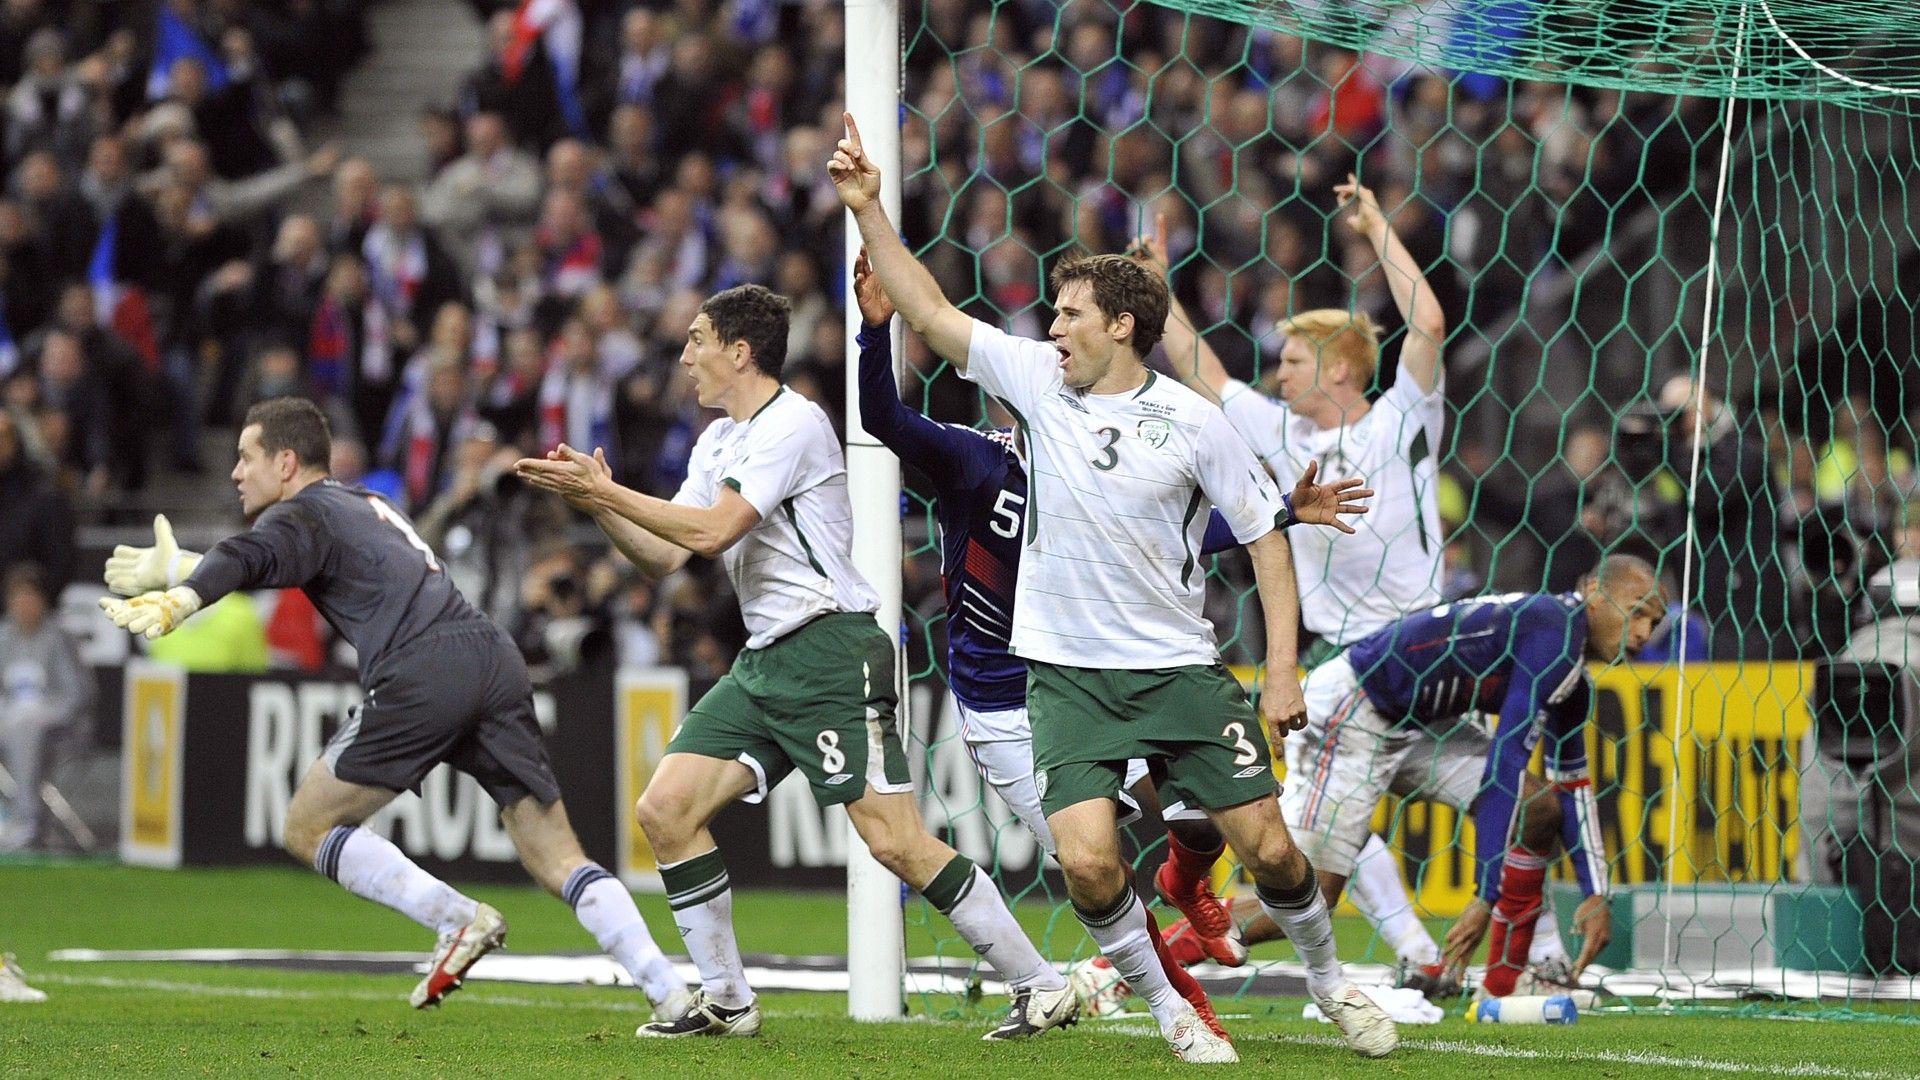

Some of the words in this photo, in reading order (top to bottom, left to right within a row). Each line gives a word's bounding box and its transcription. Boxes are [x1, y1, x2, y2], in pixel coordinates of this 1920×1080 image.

[1090, 426, 1121, 472] 3
[989, 489, 1026, 540] 5
[815, 729, 847, 775] 8
[1221, 721, 1259, 767] 3
